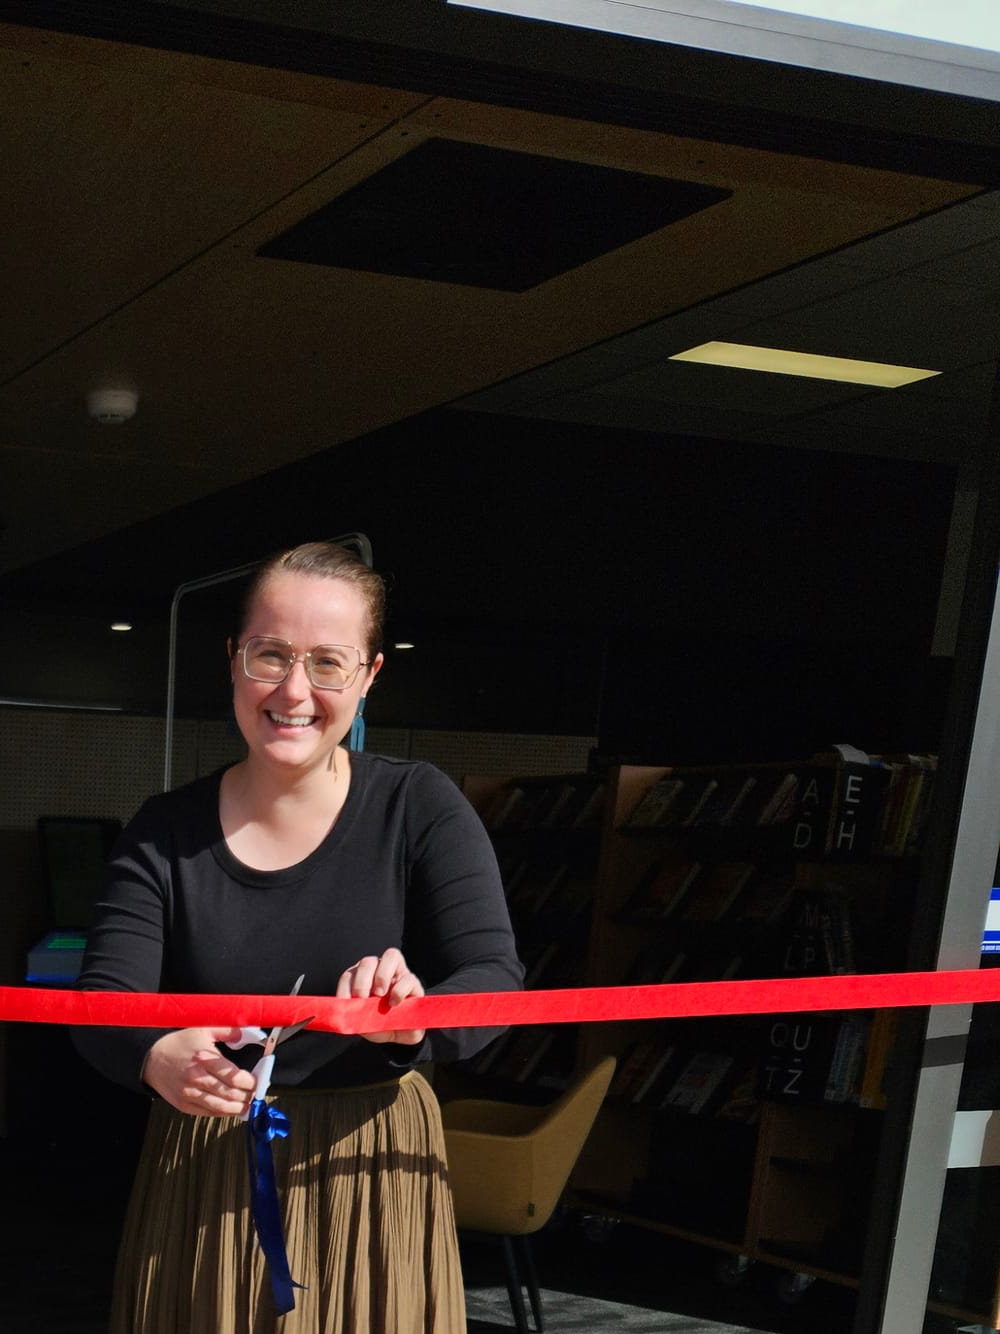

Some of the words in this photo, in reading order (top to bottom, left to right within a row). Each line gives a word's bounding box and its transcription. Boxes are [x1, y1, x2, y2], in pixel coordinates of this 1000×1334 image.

[801, 776, 820, 805] A
[845, 775, 864, 804] E
[792, 823, 812, 849] D
[837, 821, 857, 850] H
[792, 1024, 812, 1051] U
[783, 1069, 803, 1095] Z
